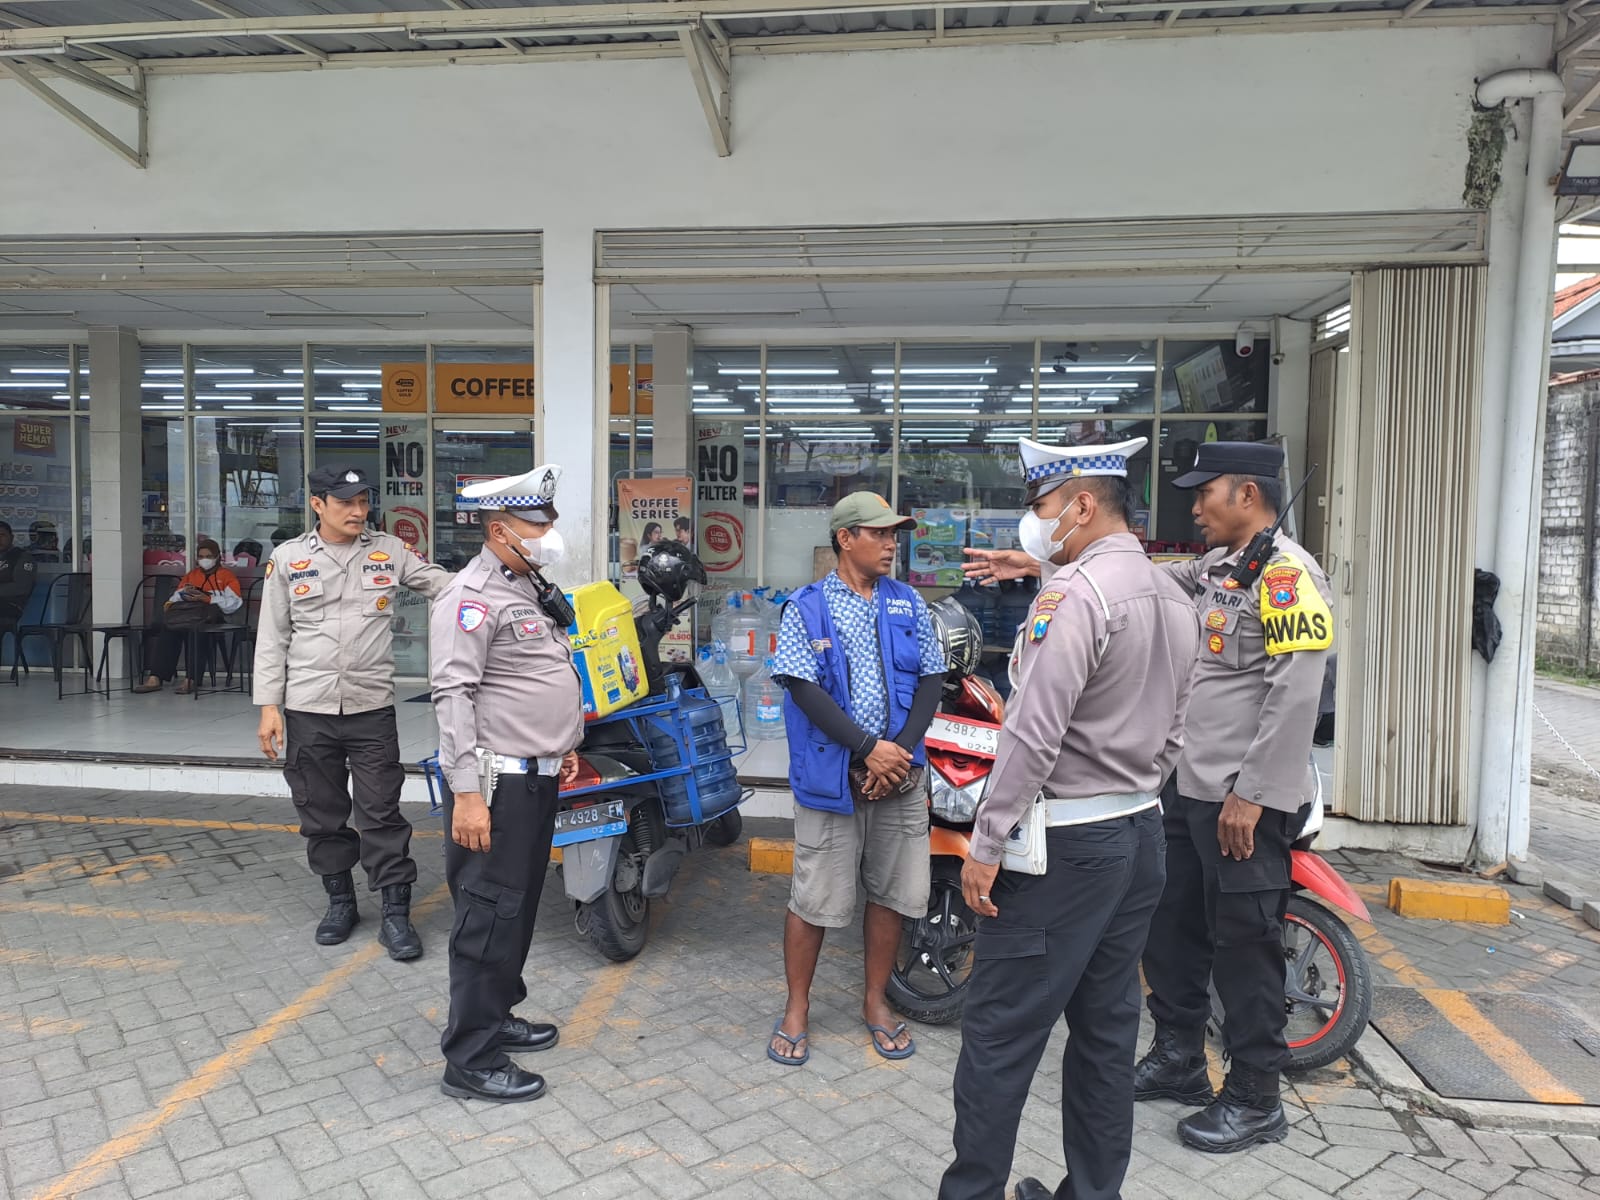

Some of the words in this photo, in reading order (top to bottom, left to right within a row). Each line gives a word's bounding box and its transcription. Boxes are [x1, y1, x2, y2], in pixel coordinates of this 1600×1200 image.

[451, 378, 534, 396] COFFEE
[20, 423, 52, 435] SUPER
[386, 425, 407, 434] NEW
[20, 433, 52, 445] HEMAT
[386, 442, 423, 478] NO
[698, 445, 738, 482] NO
[386, 481, 423, 496] FILTER
[698, 485, 737, 501] FILTER
[632, 498, 679, 508] COFFEE
[632, 509, 679, 519] SERIES
[363, 563, 394, 573] POLRI
[570, 809, 599, 825] 4928
